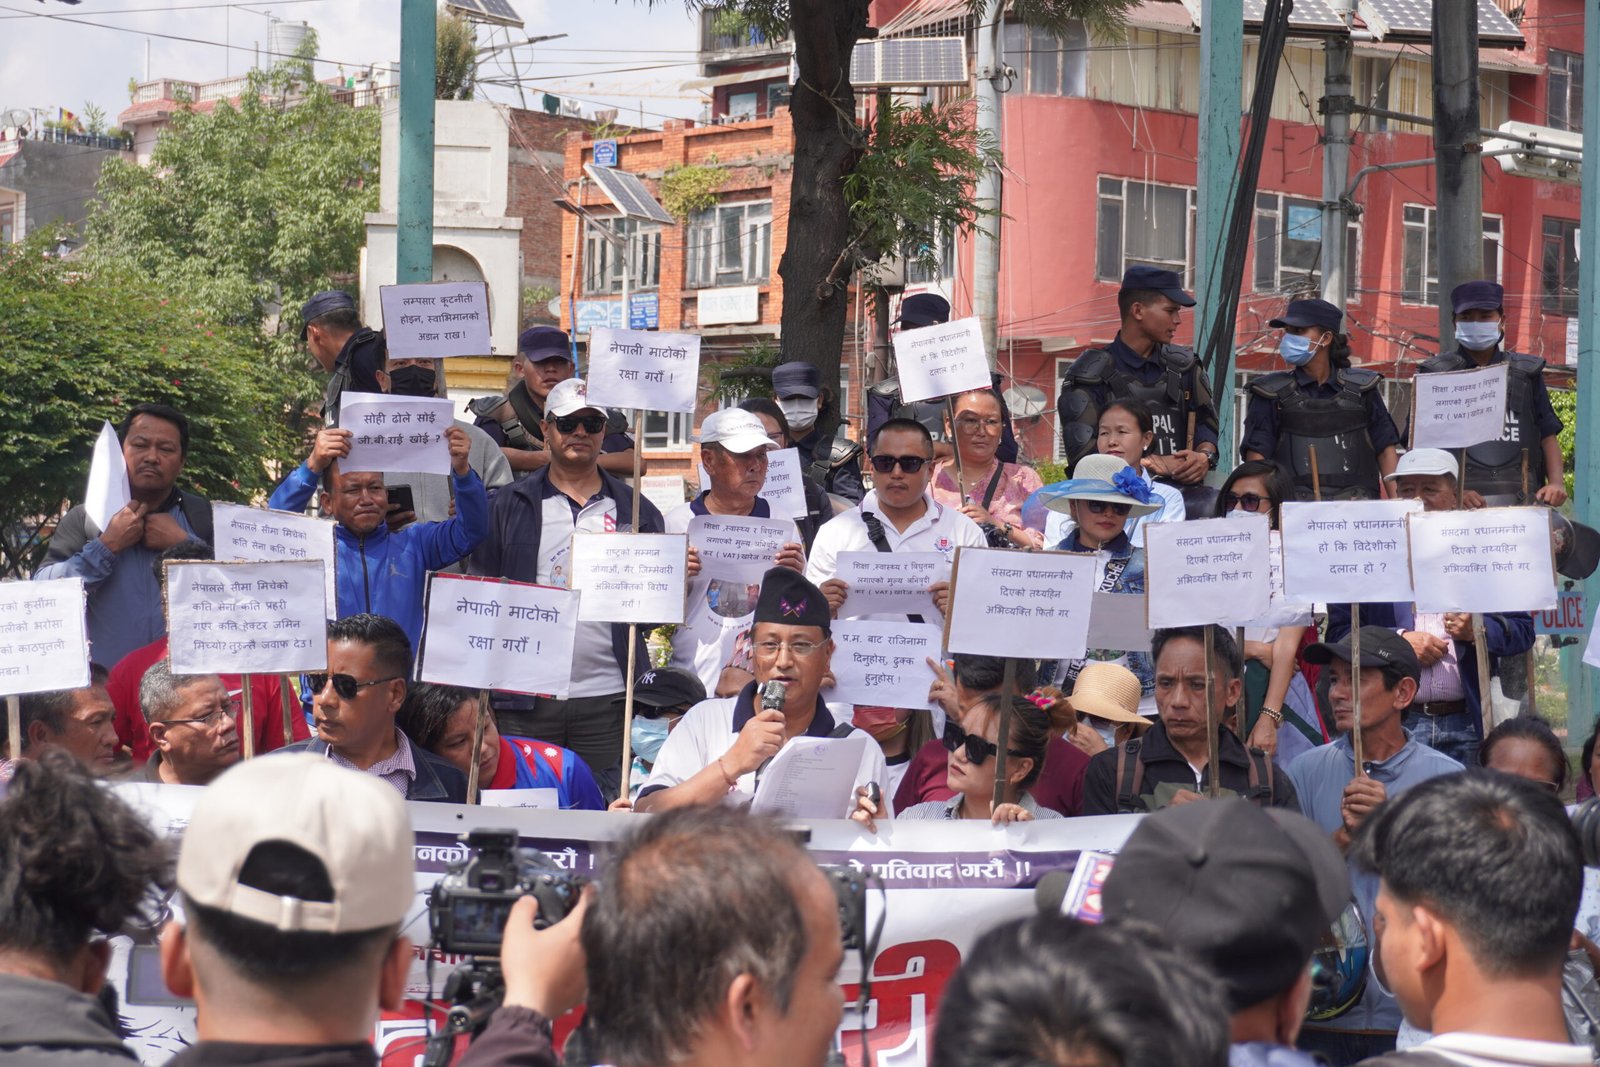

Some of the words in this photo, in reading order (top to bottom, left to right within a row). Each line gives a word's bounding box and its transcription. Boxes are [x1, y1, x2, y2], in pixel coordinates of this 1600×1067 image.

[403, 297, 436, 306] लम्पसार
[440, 294, 473, 307] कूटनीती
[401, 314, 424, 325] होइन,
[428, 311, 479, 324] स्वाभिमानको
[418, 333, 439, 341] अडान
[444, 332, 460, 340] राख
[610, 341, 643, 356] नेपाली
[649, 346, 687, 360] माटोको
[619, 369, 639, 381] रक्षा
[645, 369, 664, 383] गरौं
[364, 412, 386, 424] सोही
[392, 412, 411, 424] ढोले
[417, 412, 436, 424] सोई
[410, 432, 429, 444] खोई
[231, 520, 257, 531] नेपालले
[262, 524, 278, 535] सीमा
[283, 528, 307, 540] मिचेको
[1308, 519, 1347, 531] नेपालको
[1354, 517, 1406, 530] प्रधानमन्त्री
[232, 537, 247, 546] कति
[252, 540, 266, 550] सेना
[270, 544, 286, 554] कति
[290, 548, 306, 558] प्रहरी
[1319, 541, 1328, 554] हो
[1335, 540, 1348, 552] कि
[1354, 539, 1397, 552] विदेशीको
[992, 565, 1022, 578] संसदमा
[1027, 570, 1074, 581] प्रधानमन्त्रीले
[1330, 564, 1358, 573] दलाल
[1364, 562, 1374, 574] हो
[1380, 563, 1387, 572] ?
[192, 581, 224, 592] नेपालले
[231, 582, 251, 592] सीमा
[258, 580, 288, 591] मिचेको
[1000, 586, 1025, 597] दिएको
[1030, 588, 1061, 600] तथ्यहिन
[24, 598, 56, 615] कुर्सीमा
[193, 601, 212, 611] कति
[218, 602, 235, 611] सेना
[241, 600, 260, 611] कति
[266, 599, 286, 611] प्रहरी
[457, 597, 501, 617] नेपाली
[509, 605, 560, 623] माटोको
[986, 604, 1032, 616] अभिव्यक्ति
[1036, 607, 1054, 617] फिर्ता
[1058, 610, 1070, 618] गर
[34, 619, 63, 630] भरोसा
[193, 623, 212, 631] गएर
[219, 620, 238, 631] कति
[243, 620, 268, 632] हेक्टर
[274, 618, 300, 629] जमिन
[19, 639, 65, 656] काठपुतली
[262, 640, 289, 649] जवाफ
[469, 635, 495, 650] रक्षा
[503, 636, 530, 653] गरौं
[537, 641, 541, 655] !
[868, 636, 884, 644] बाट
[888, 635, 927, 646] राजिनामा
[893, 657, 915, 668] ढुक्क
